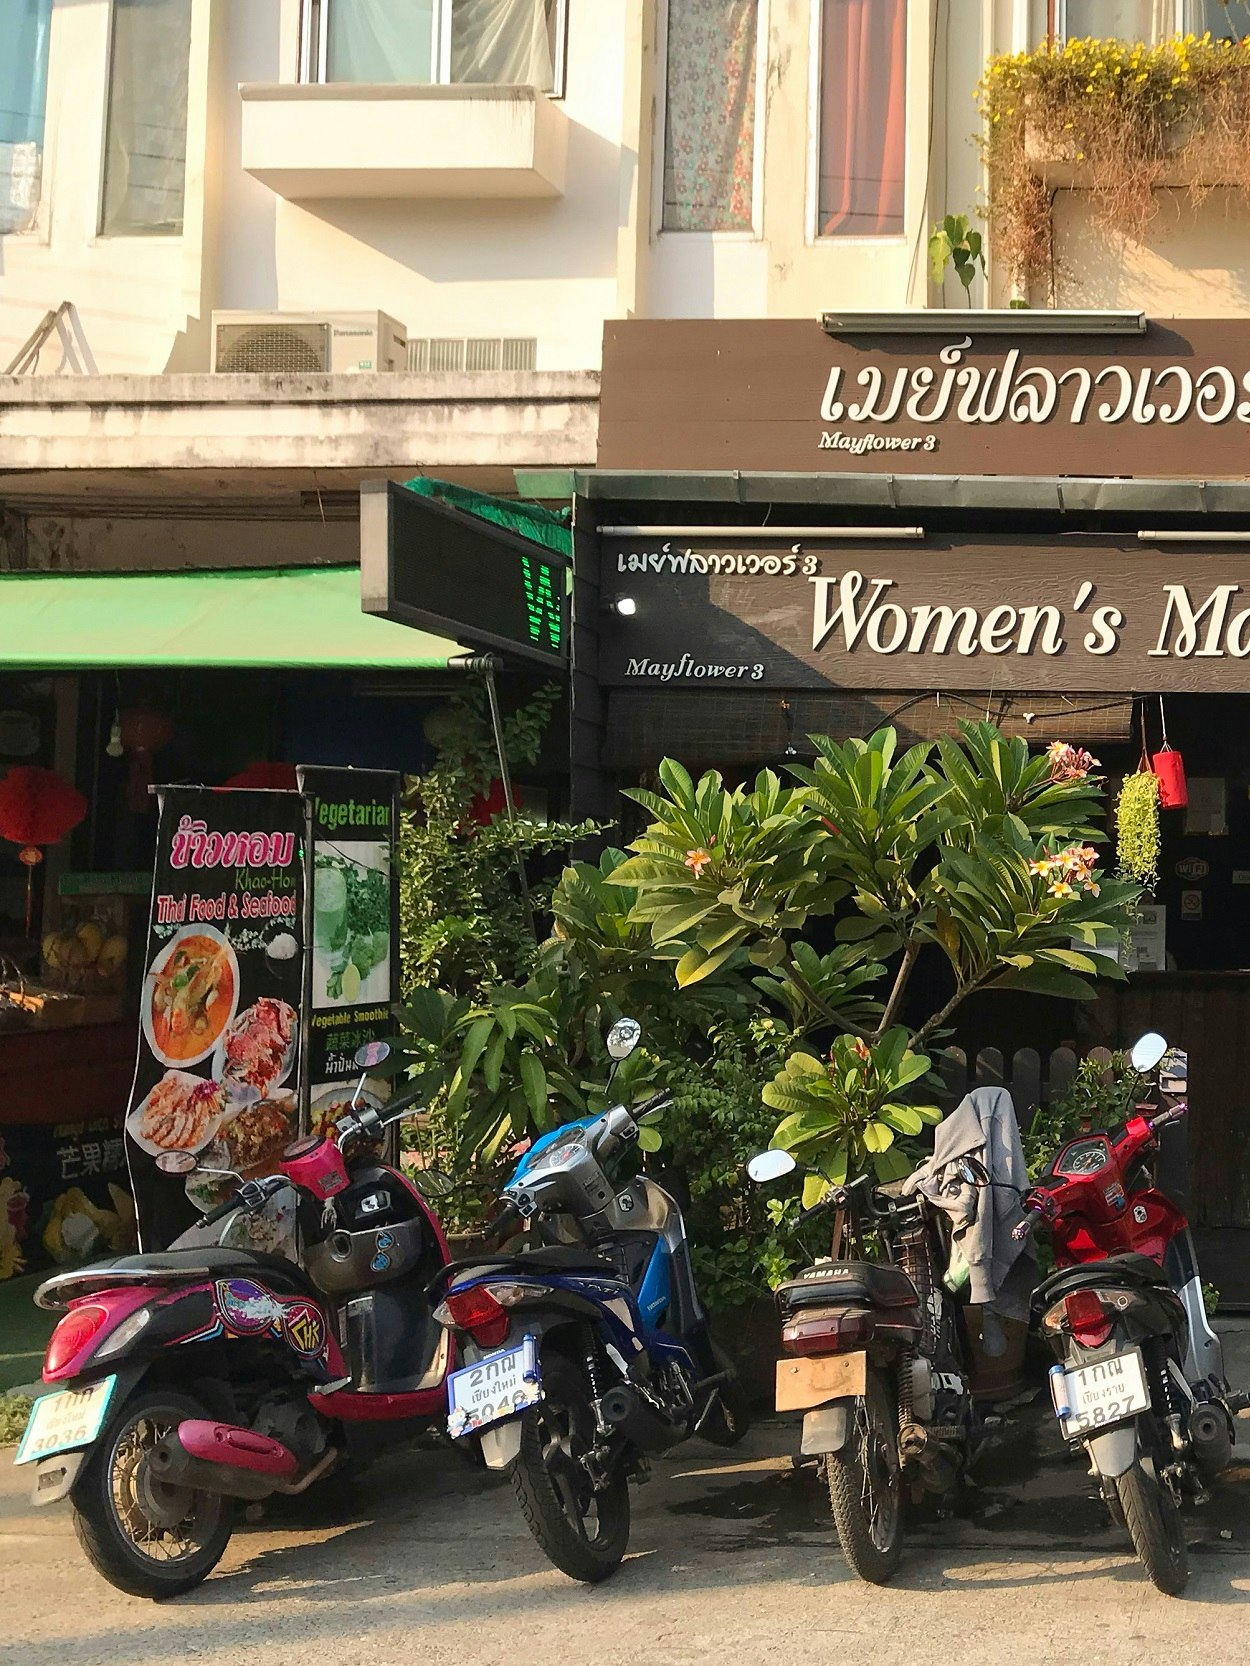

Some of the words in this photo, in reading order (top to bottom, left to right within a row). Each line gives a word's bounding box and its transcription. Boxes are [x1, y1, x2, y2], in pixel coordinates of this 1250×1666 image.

[818, 431, 921, 454] Mayflower
[923, 435, 936, 451] 3
[617, 543, 800, 575] เมย์ฟลาวเวอร์
[802, 554, 819, 576] 3
[808, 570, 1124, 655] Women's
[625, 654, 749, 681] Mayflower
[751, 664, 764, 680] 3
[169, 814, 295, 869] ข้าวหอม
[189, 893, 225, 922] Food
[228, 892, 238, 919] &
[804, 1268, 849, 1279] YAMAHA
[472, 1374, 517, 1404] เชียงใหม่
[1075, 1394, 1135, 1430] 5827
